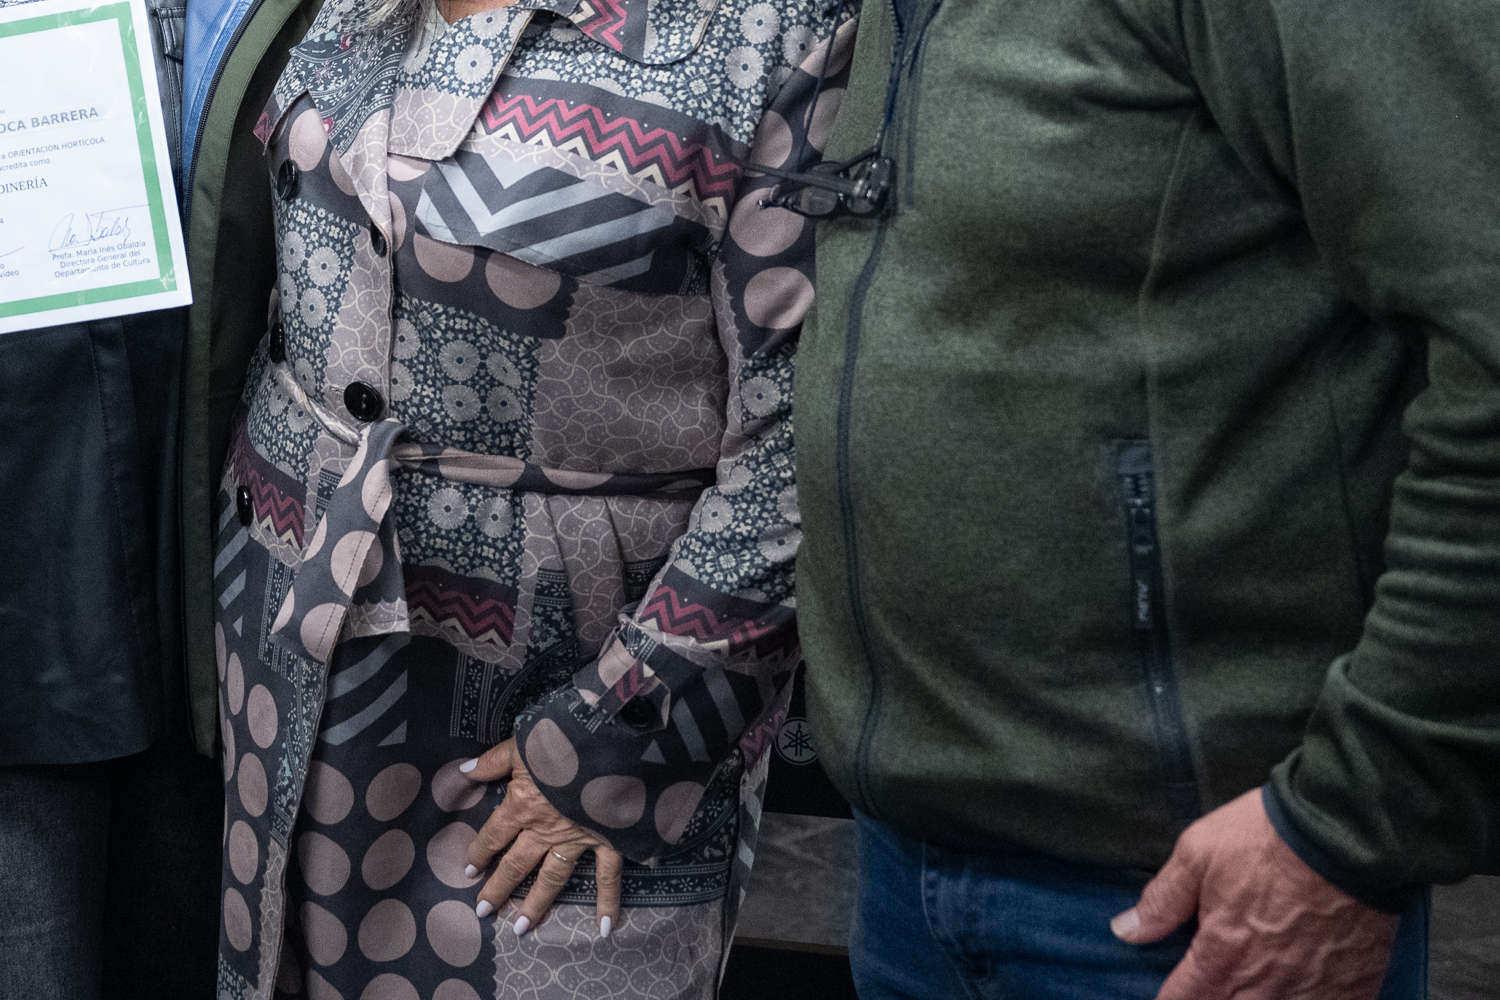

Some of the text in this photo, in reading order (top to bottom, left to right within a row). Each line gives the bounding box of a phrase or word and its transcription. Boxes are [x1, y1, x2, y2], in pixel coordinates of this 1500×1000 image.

[30, 107, 99, 128] BARRERA
[61, 135, 105, 150] HORTÍCOLA
[29, 157, 51, 168] como
[52, 239, 146, 260] Profa. María Inés Obaldía
[60, 249, 141, 269] Directora General del
[111, 261, 121, 270] de
[122, 256, 151, 268] Cultura
